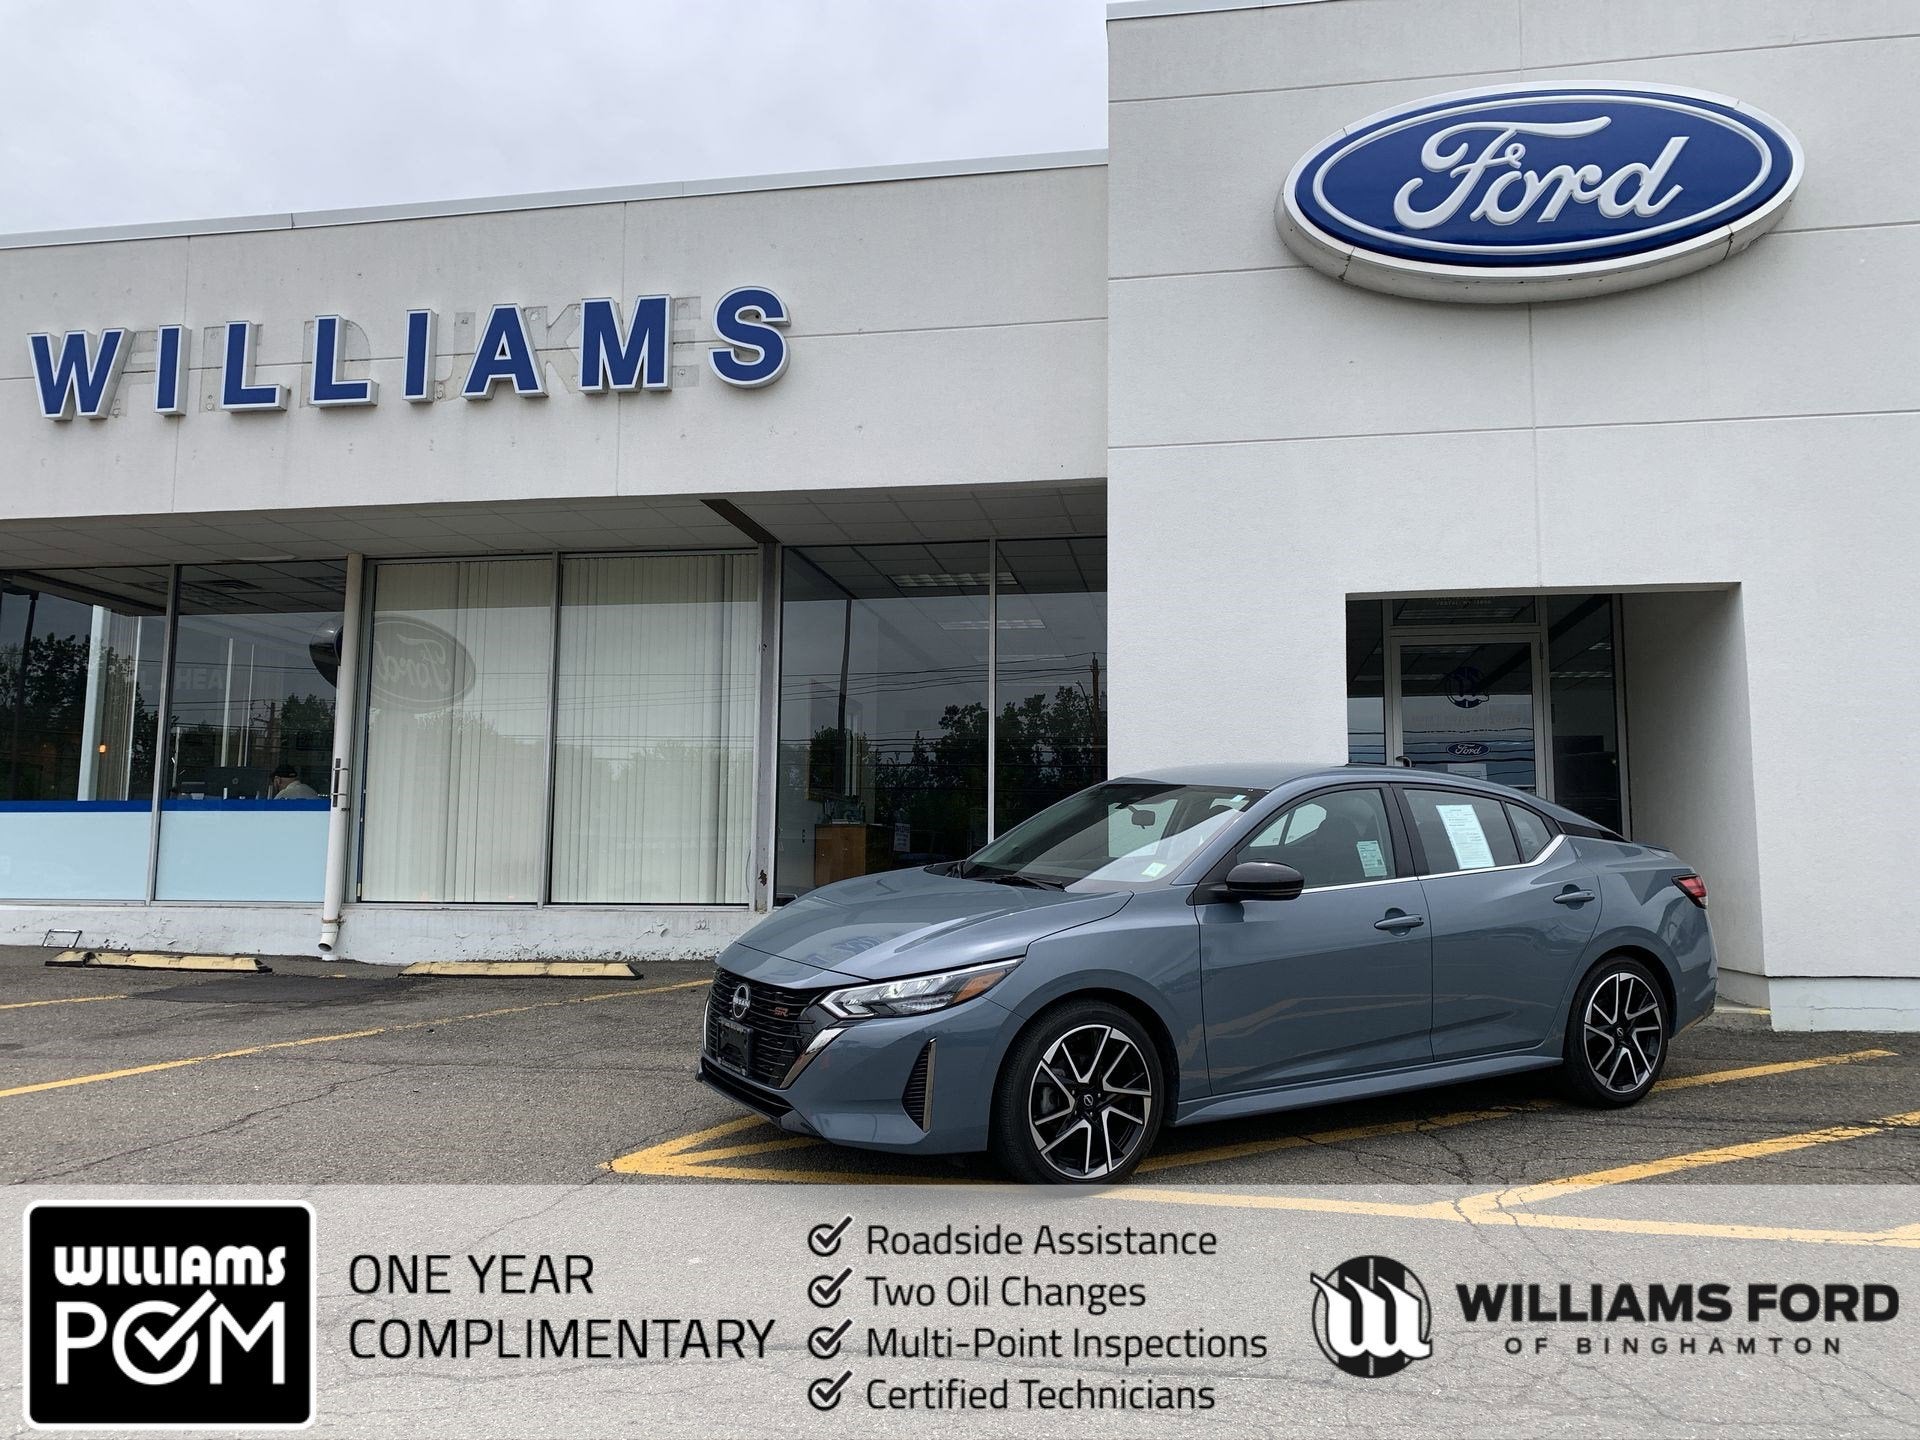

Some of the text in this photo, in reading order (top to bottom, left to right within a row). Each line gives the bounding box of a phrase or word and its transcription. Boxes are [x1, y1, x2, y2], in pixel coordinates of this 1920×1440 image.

[1394, 116, 1689, 230] Ford
[27, 286, 792, 421] WILLIAMS
[1455, 744, 1482, 755] Ford
